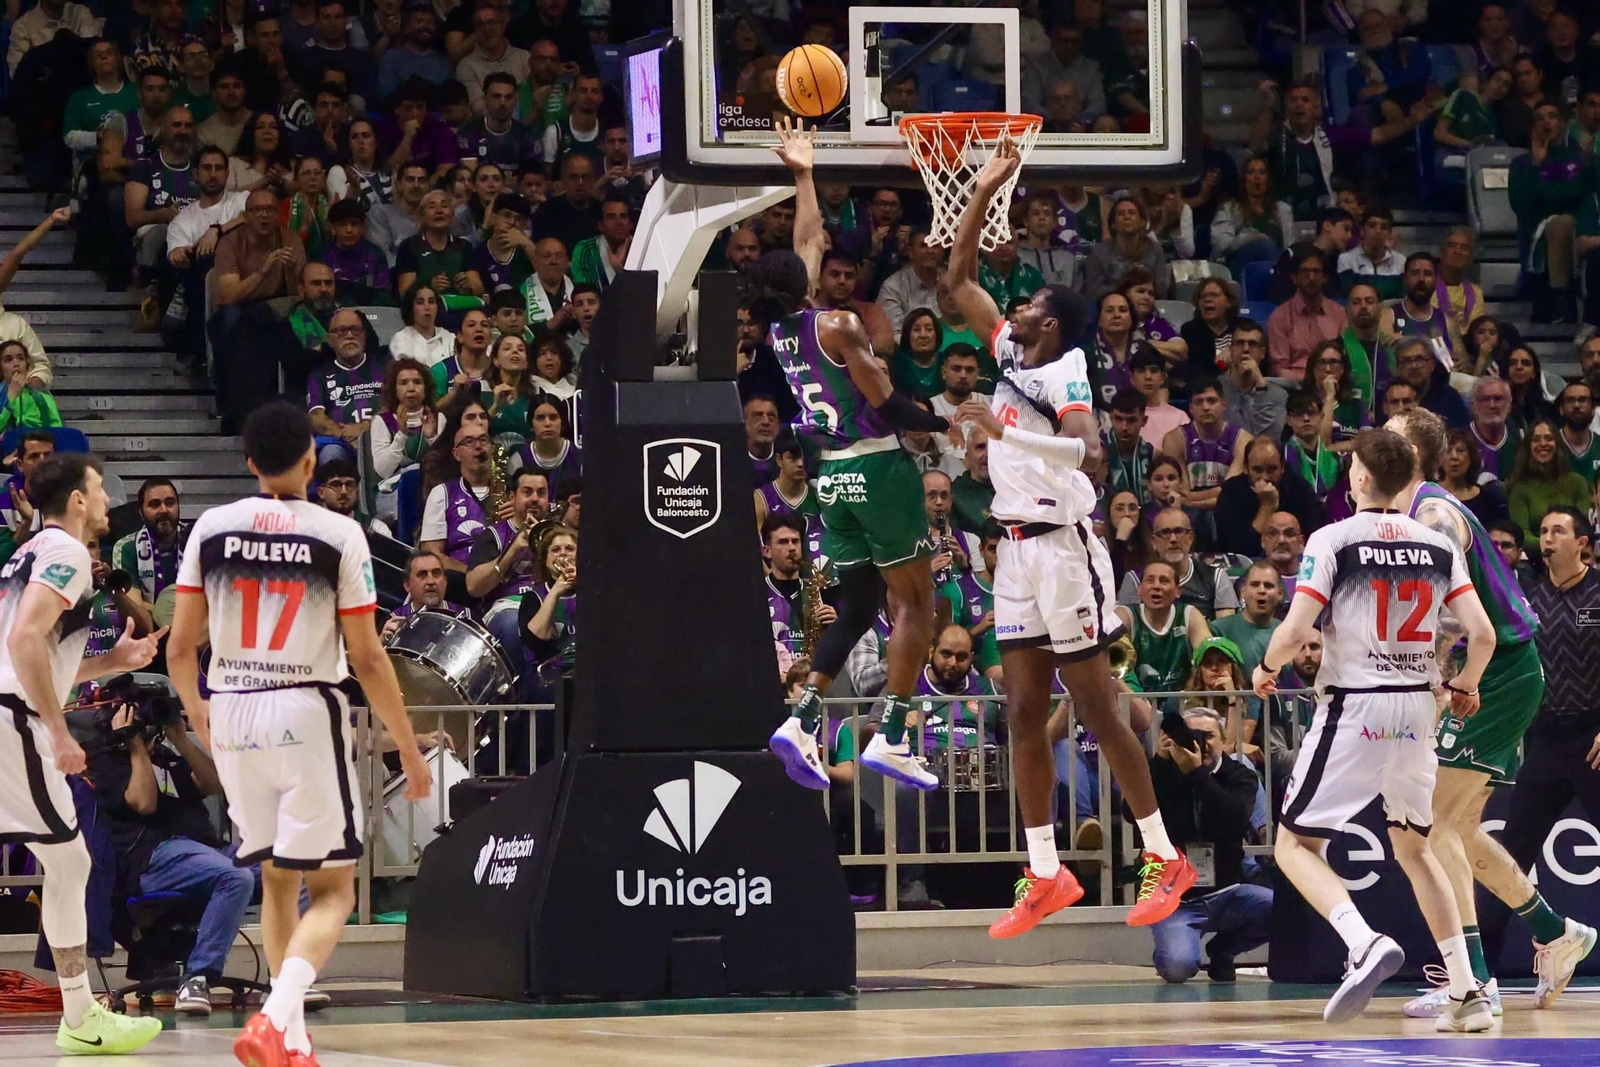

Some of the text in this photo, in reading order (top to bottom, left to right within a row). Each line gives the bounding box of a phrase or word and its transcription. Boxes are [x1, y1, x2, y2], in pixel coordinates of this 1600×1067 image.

[719, 103, 742, 117] liga
[719, 115, 770, 127] endesa
[656, 485, 709, 496] Fundación
[847, 485, 867, 494] SOL
[664, 497, 702, 509] Unicaja
[656, 508, 710, 517] Baloncesto
[224, 536, 312, 564] PULEVA
[1358, 546, 1434, 566] PULEVA
[233, 578, 306, 651] 17
[1370, 577, 1433, 643] 12
[217, 657, 313, 675] AYUNTAMIENTO
[1376, 663, 1392, 672] DE
[224, 675, 239, 686] DE
[493, 833, 535, 860] Fundación
[488, 859, 518, 890] Unicaja
[615, 867, 773, 917] Unicaja
